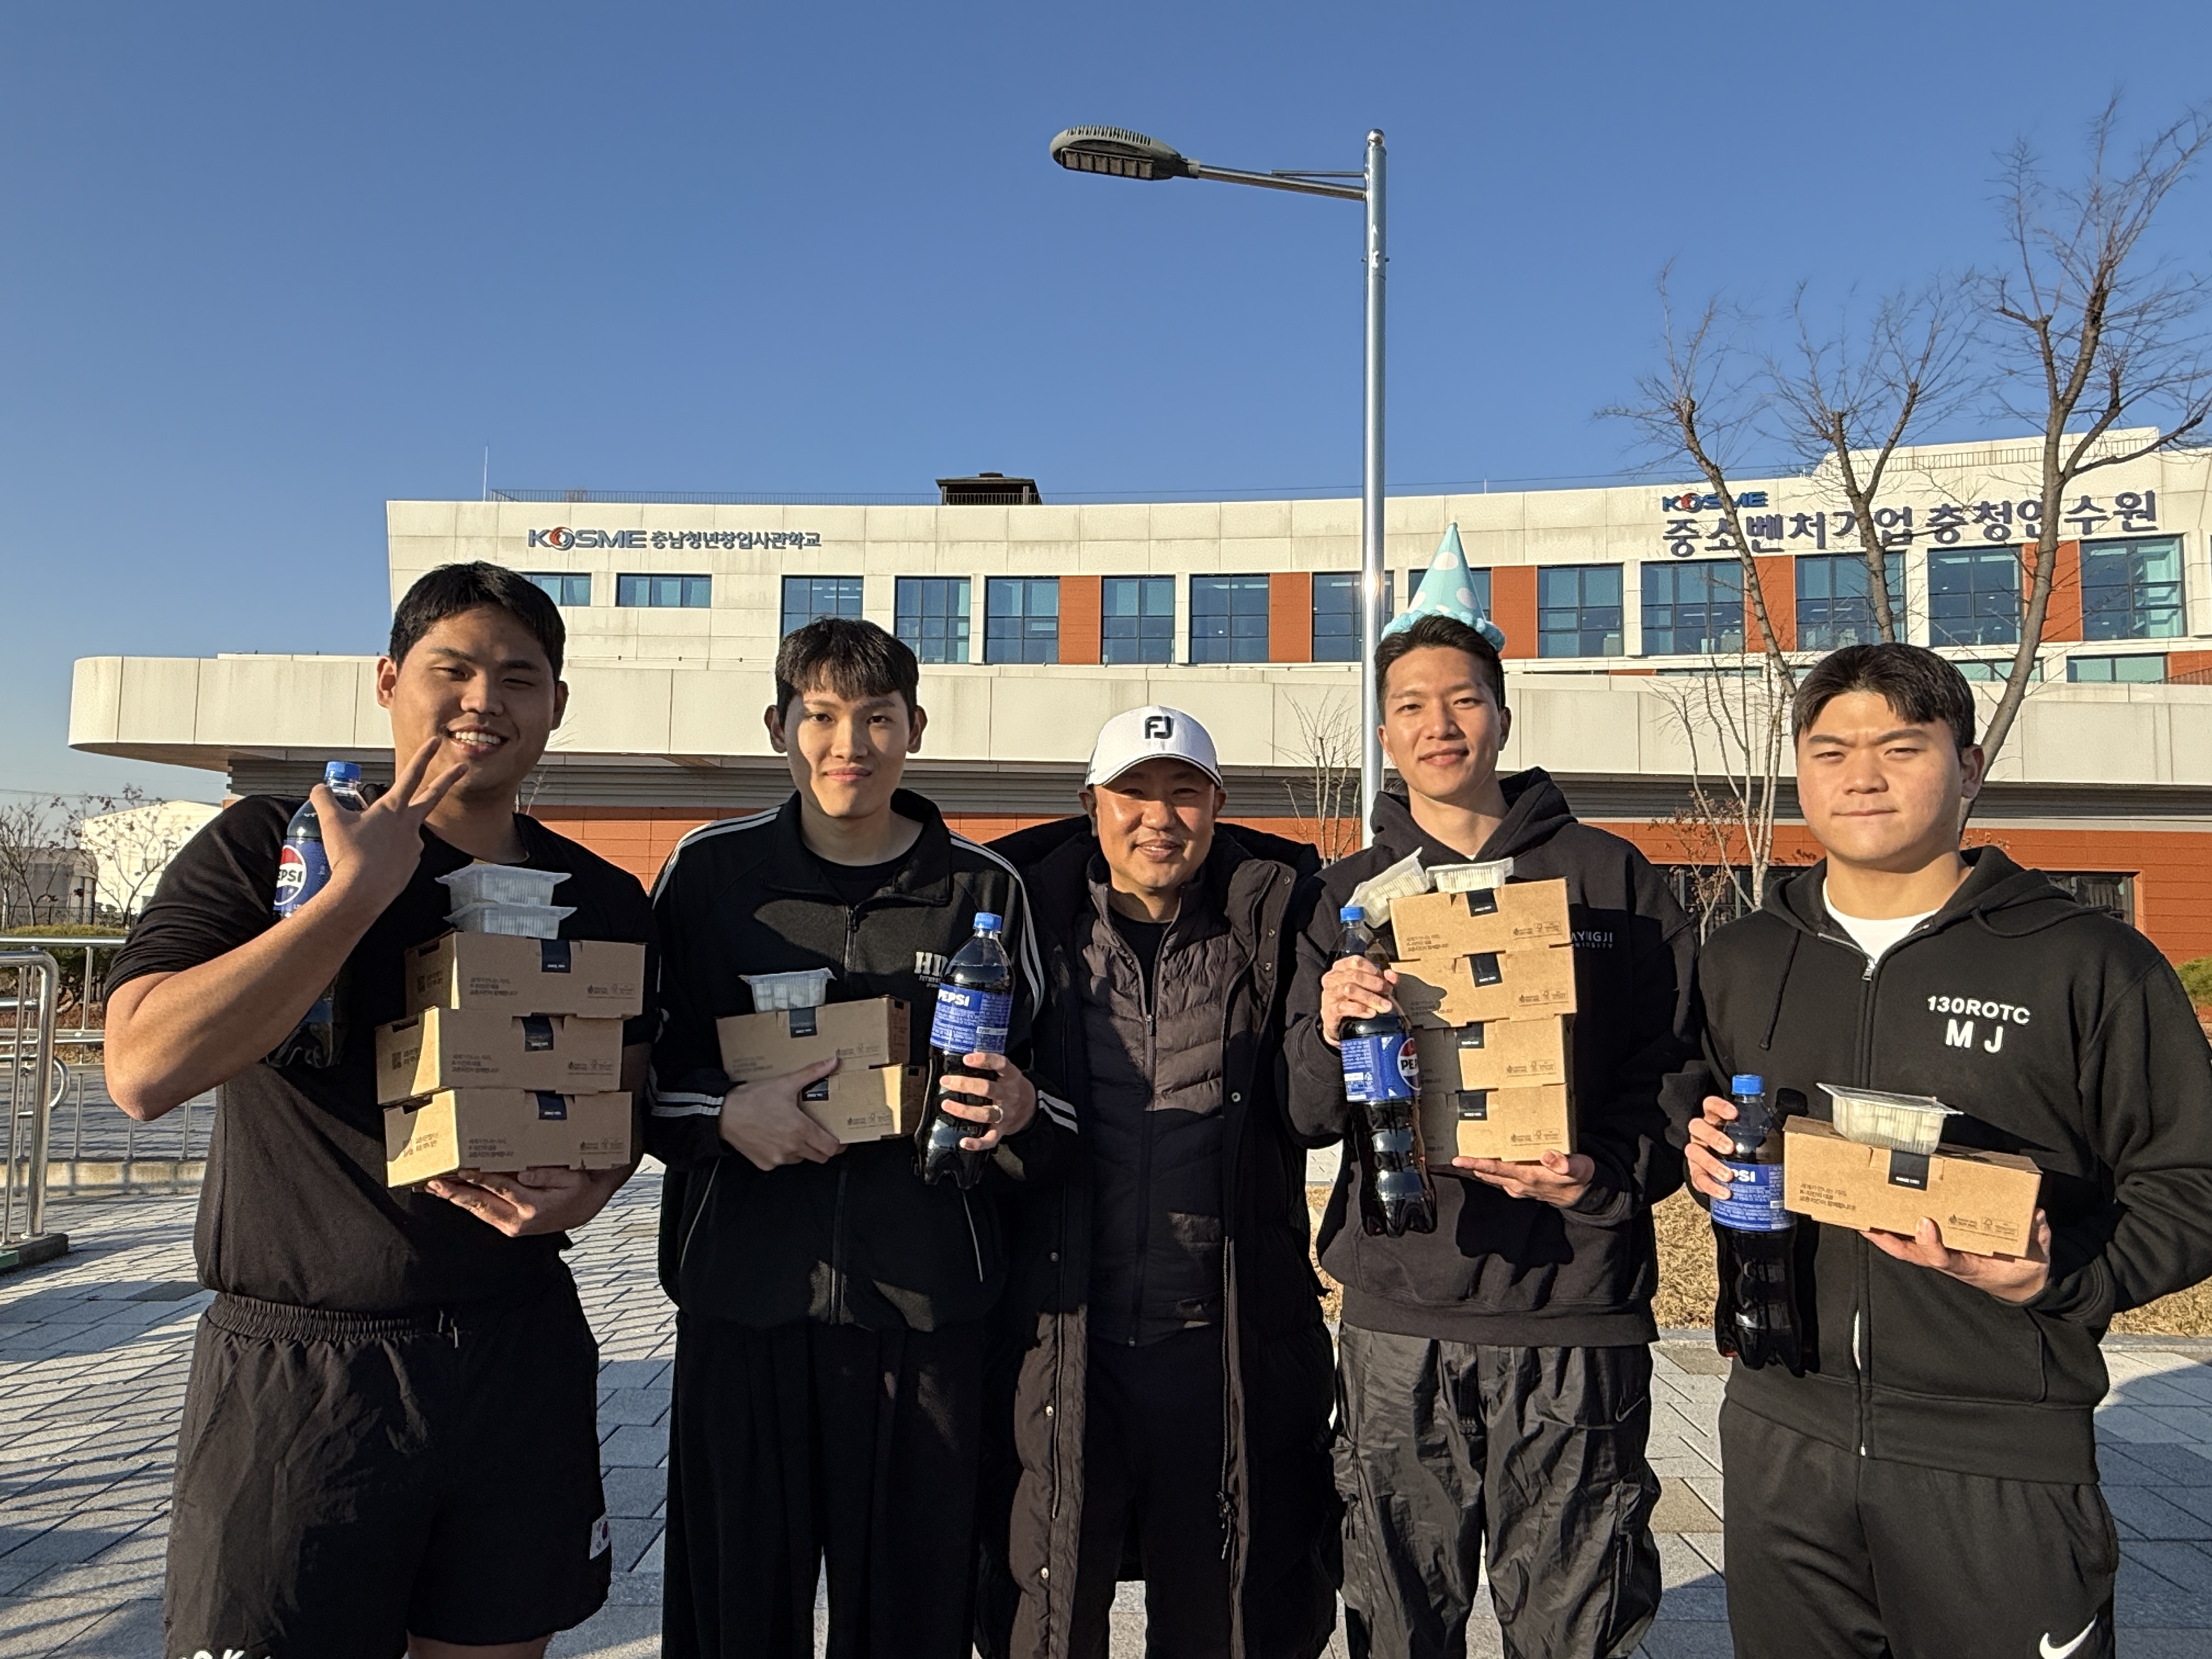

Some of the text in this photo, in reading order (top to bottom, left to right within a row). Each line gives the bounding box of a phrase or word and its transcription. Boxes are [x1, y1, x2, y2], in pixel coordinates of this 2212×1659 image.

[528, 527, 647, 550] KOSME
[1662, 506, 1914, 557] 중소벤처기업
[1928, 995, 2030, 1024] 130ROTC
[1945, 1019, 2004, 1053] M J
